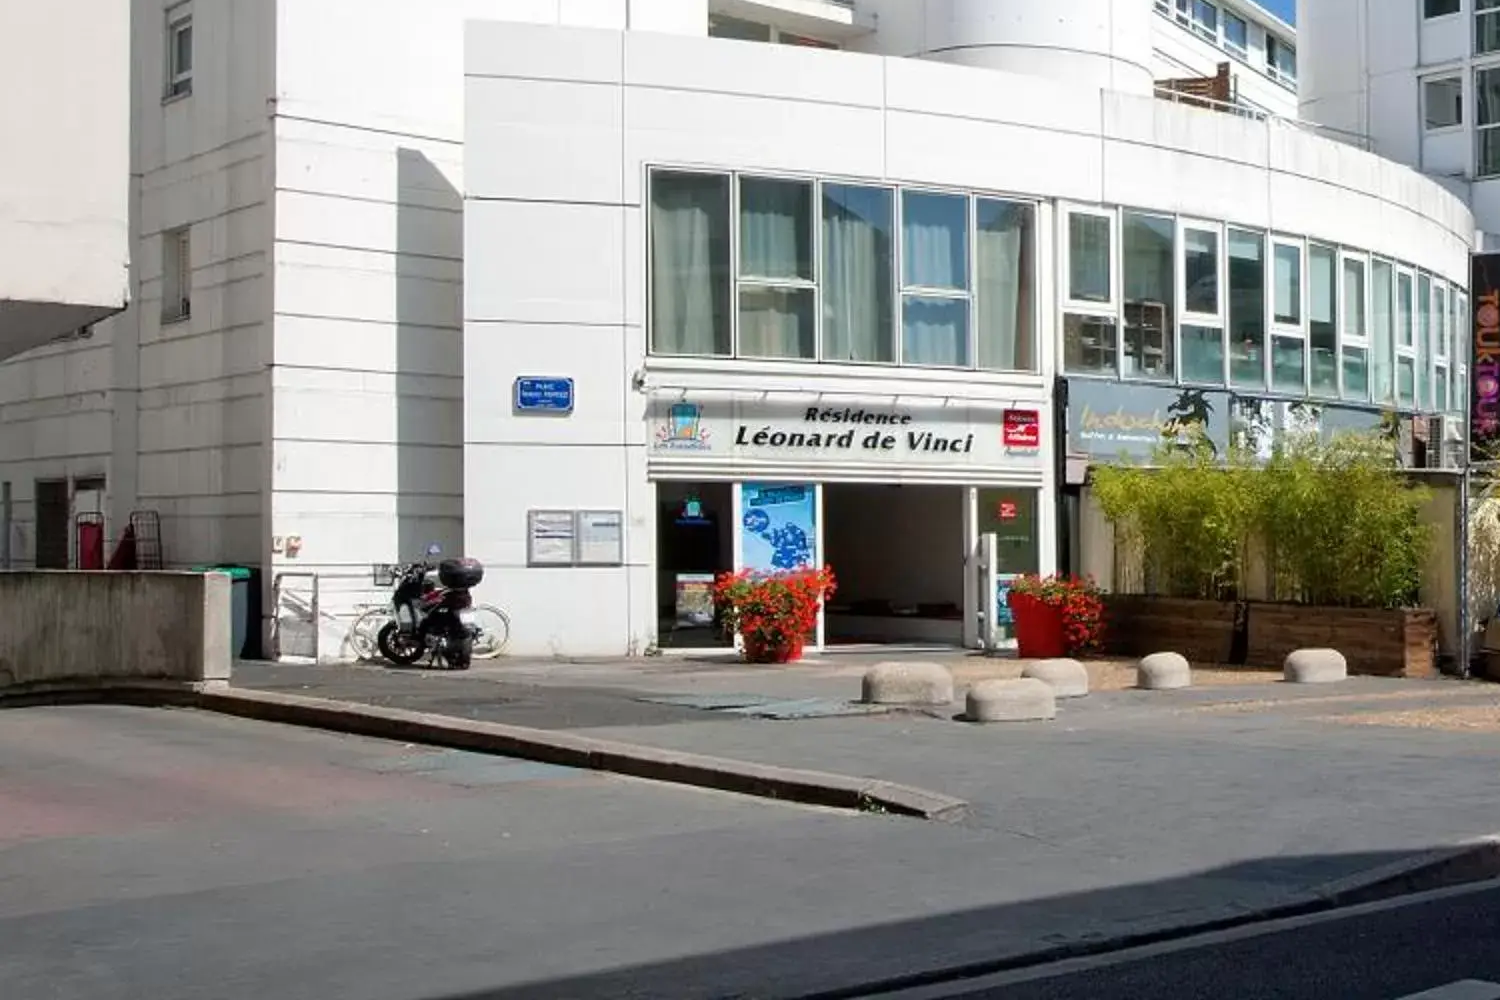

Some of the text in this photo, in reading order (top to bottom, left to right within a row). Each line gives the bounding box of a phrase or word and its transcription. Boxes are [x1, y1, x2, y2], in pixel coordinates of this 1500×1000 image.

[805, 407, 912, 425] Résidence
[735, 426, 974, 453] Léonard de Vinci
